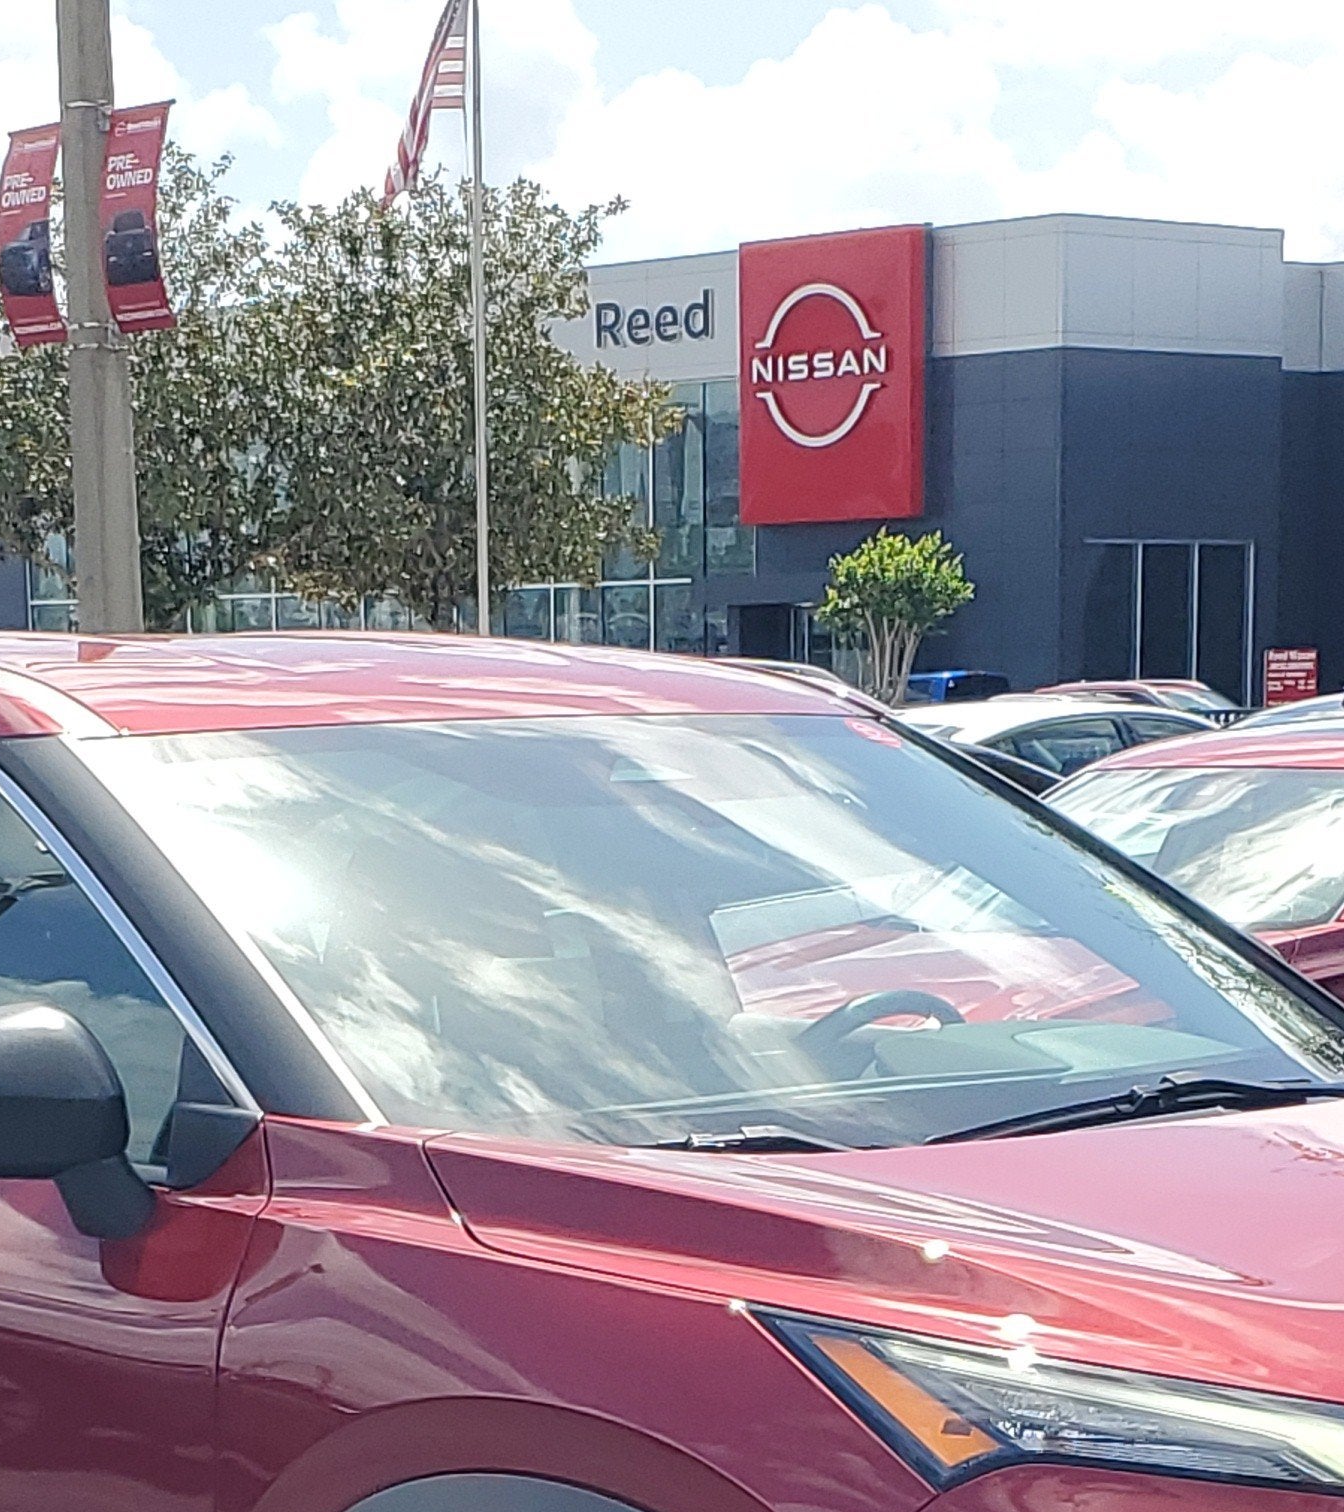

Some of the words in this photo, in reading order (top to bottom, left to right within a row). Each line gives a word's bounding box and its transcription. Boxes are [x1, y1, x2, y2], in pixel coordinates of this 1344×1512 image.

[107, 153, 140, 172] PRE-
[3, 172, 34, 191] PRE-
[106, 168, 153, 190] OWNED
[1, 186, 47, 208] OWNED
[594, 288, 716, 349] Reed
[750, 344, 888, 386] NISSAN
